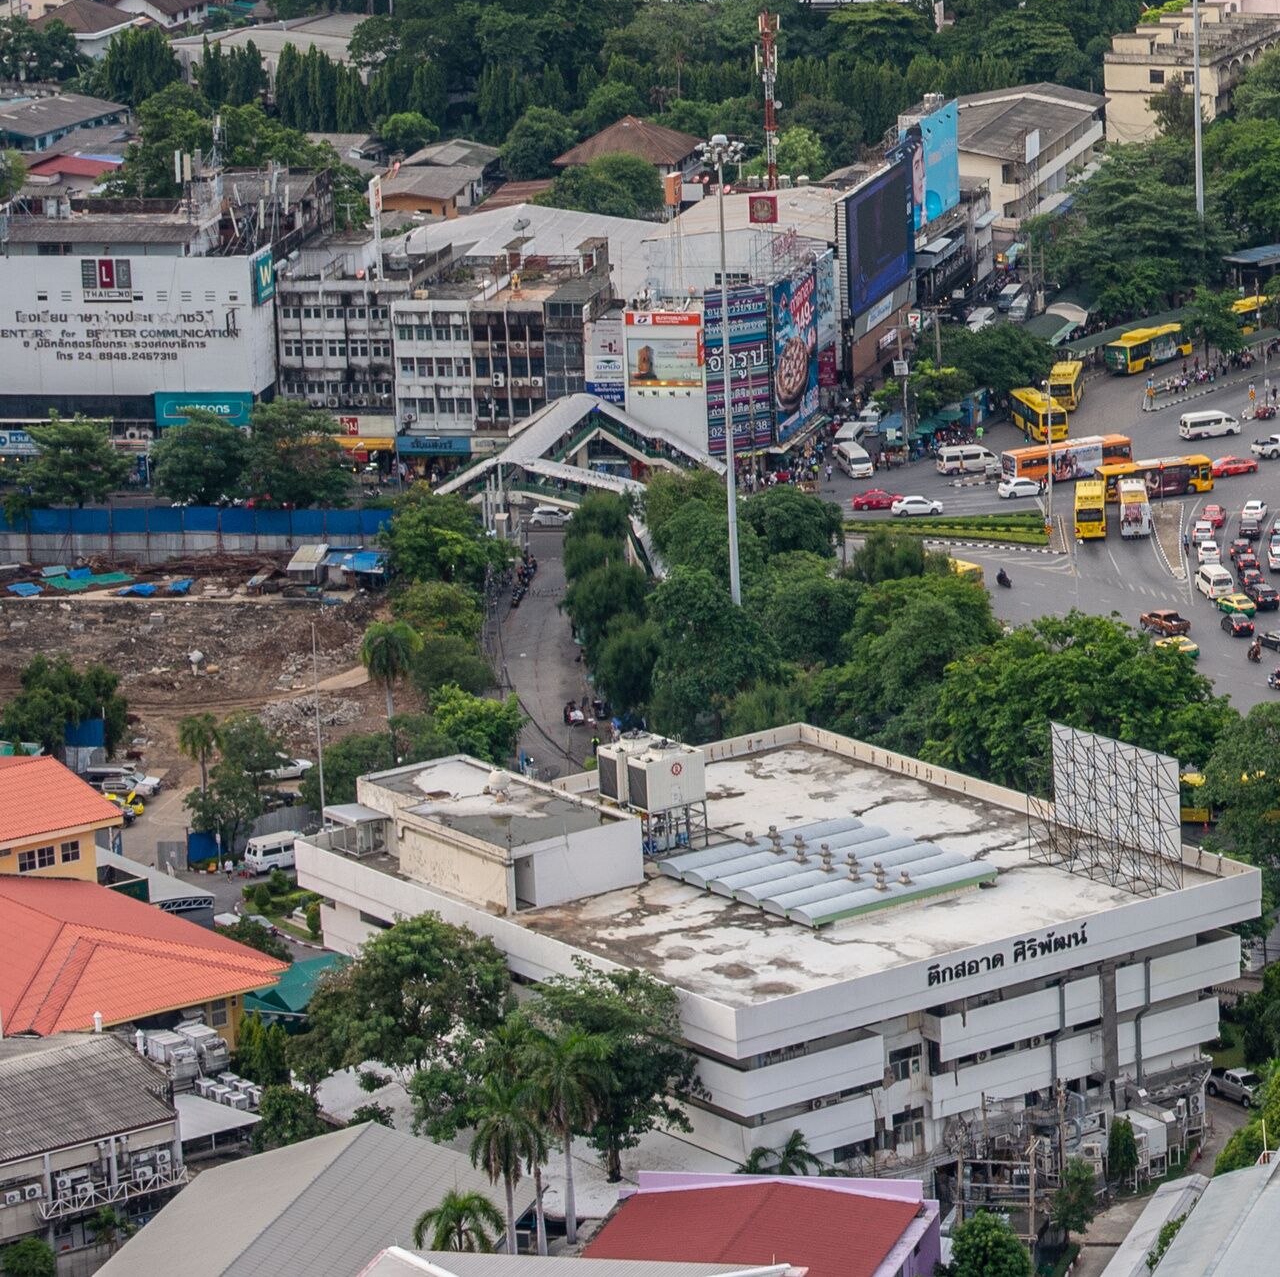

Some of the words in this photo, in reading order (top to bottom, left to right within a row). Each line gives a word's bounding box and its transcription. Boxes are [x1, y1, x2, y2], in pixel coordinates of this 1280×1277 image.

[61, 329, 76, 338] for
[928, 953, 1005, 987] ตึกสอาด
[1014, 922, 1088, 964] ศิริพัฒน์
